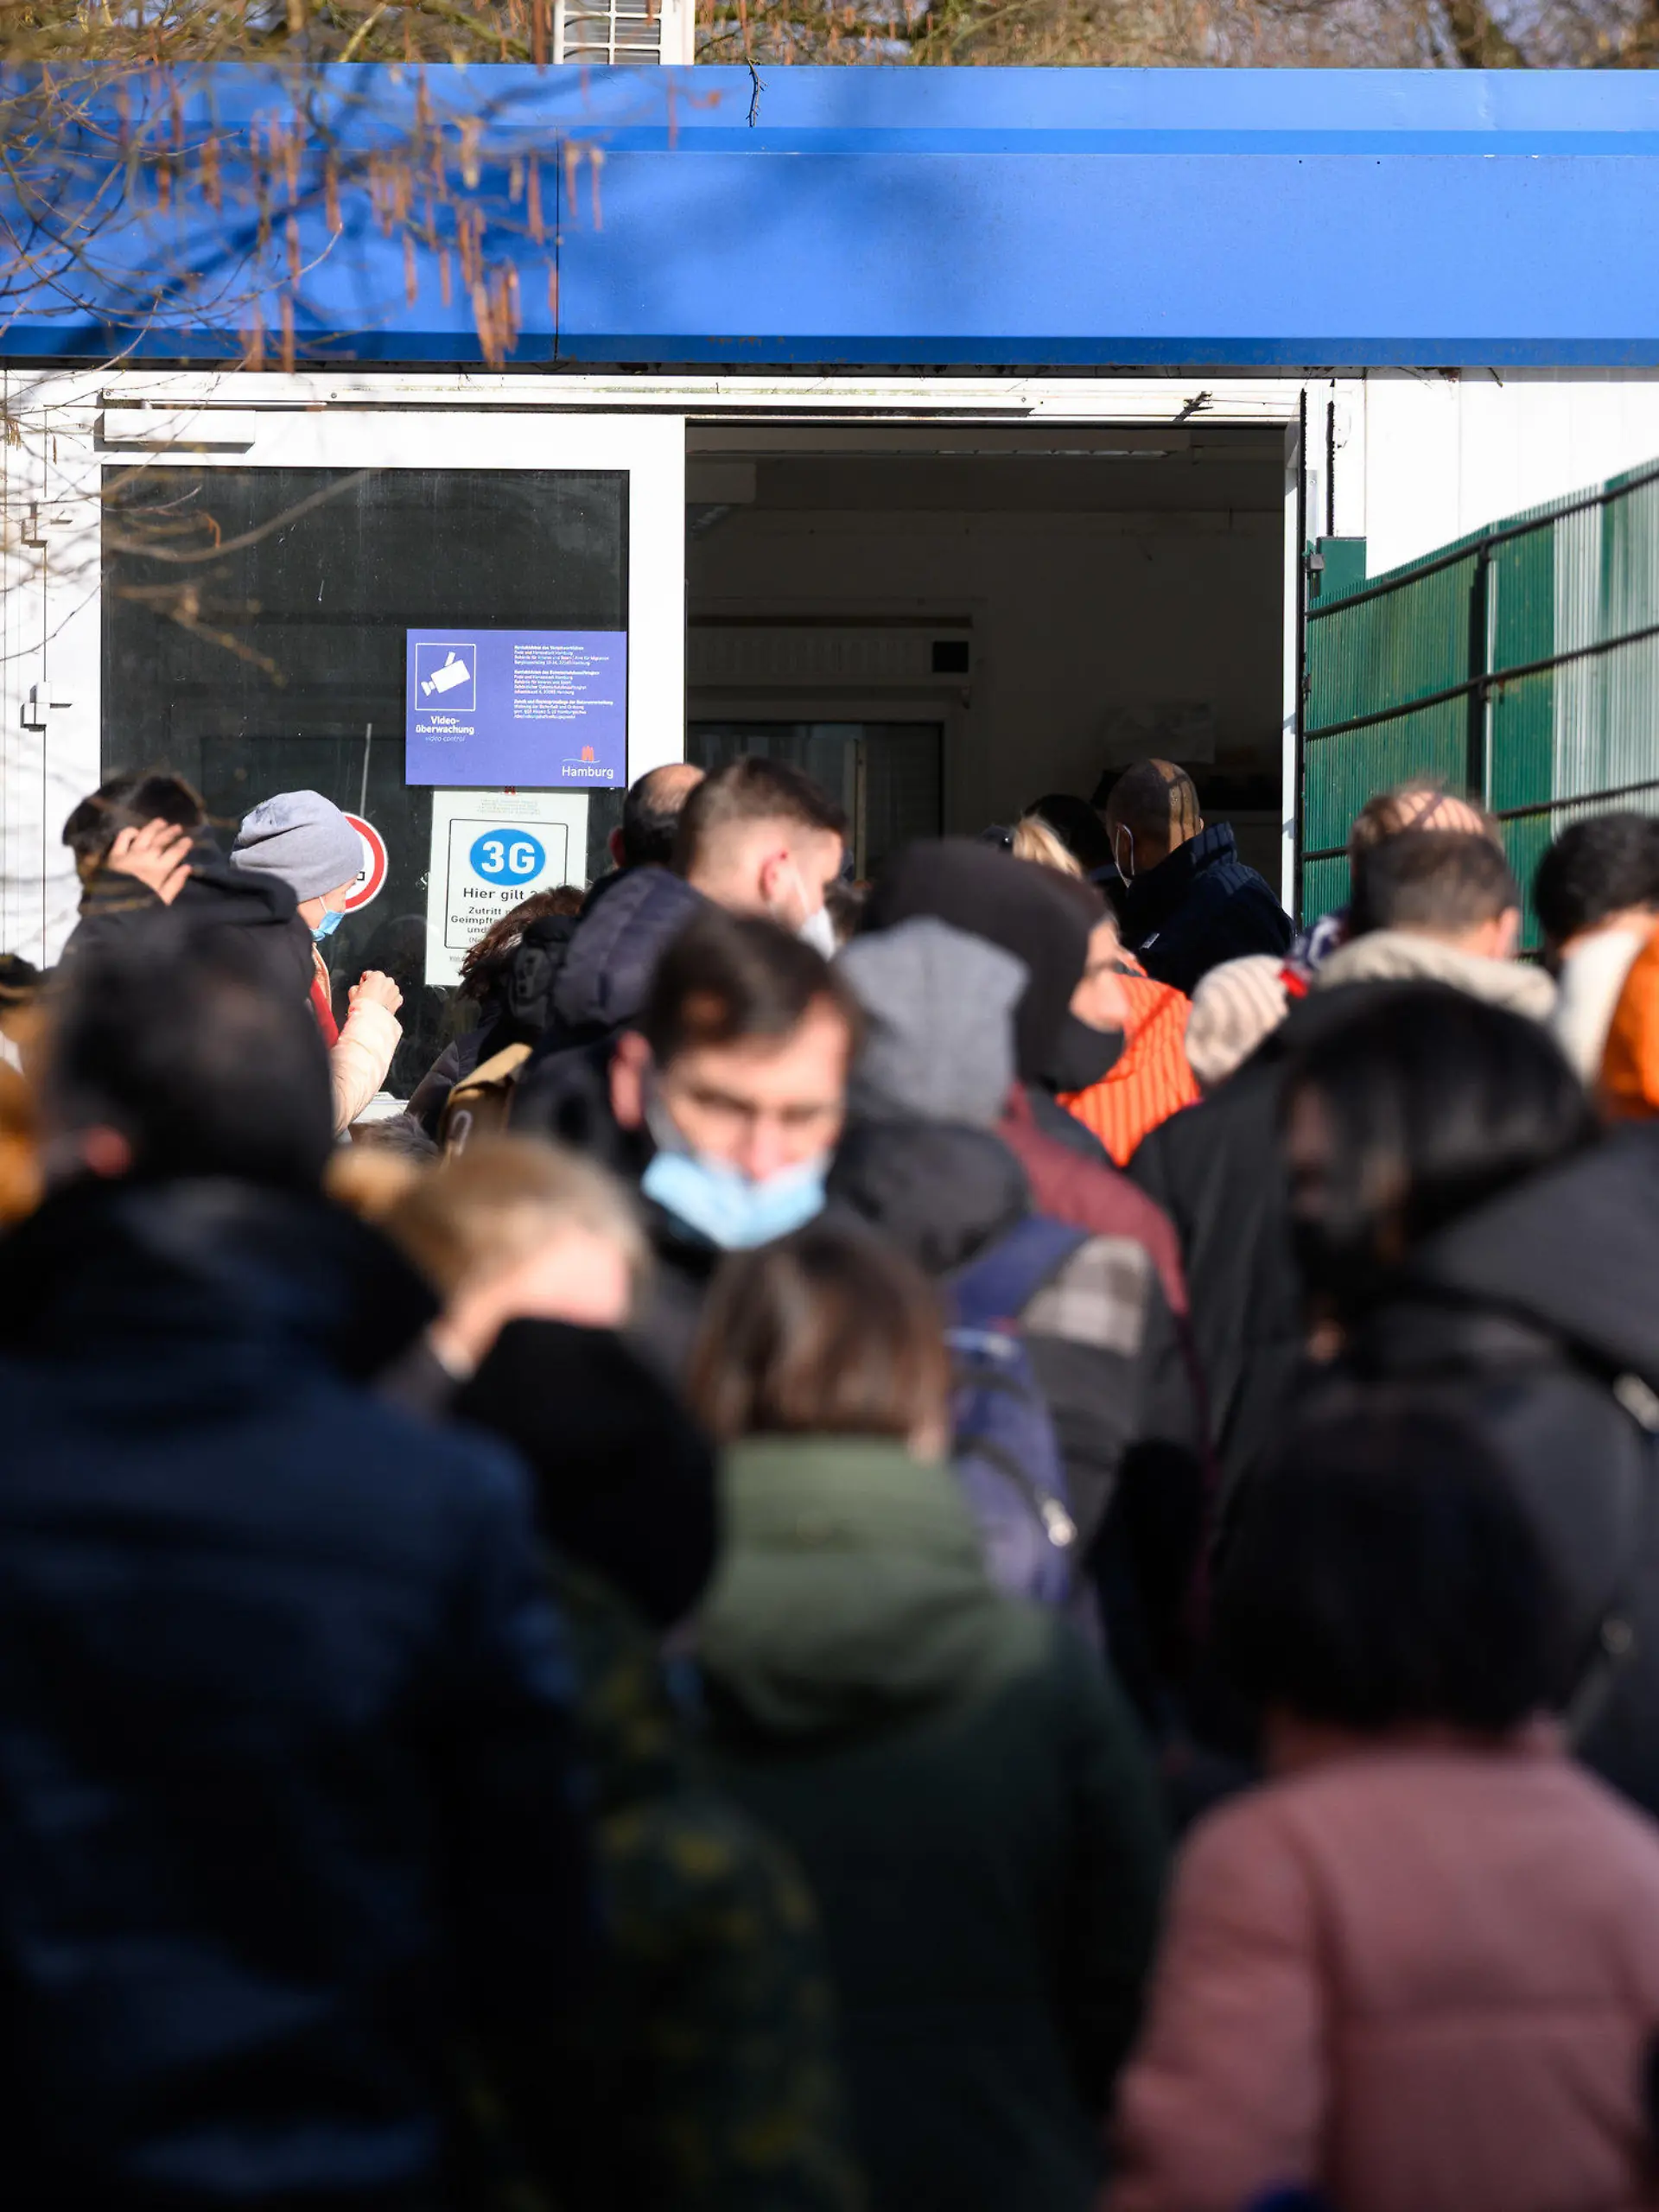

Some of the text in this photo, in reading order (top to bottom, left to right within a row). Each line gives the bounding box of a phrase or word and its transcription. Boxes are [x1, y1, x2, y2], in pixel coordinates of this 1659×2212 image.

[430, 715, 461, 725] Video-
[562, 766, 614, 779] Hamburg
[481, 840, 536, 874] 3G
[463, 887, 496, 899] Hier
[500, 889, 524, 902] gilt
[468, 906, 502, 915] Zutritt
